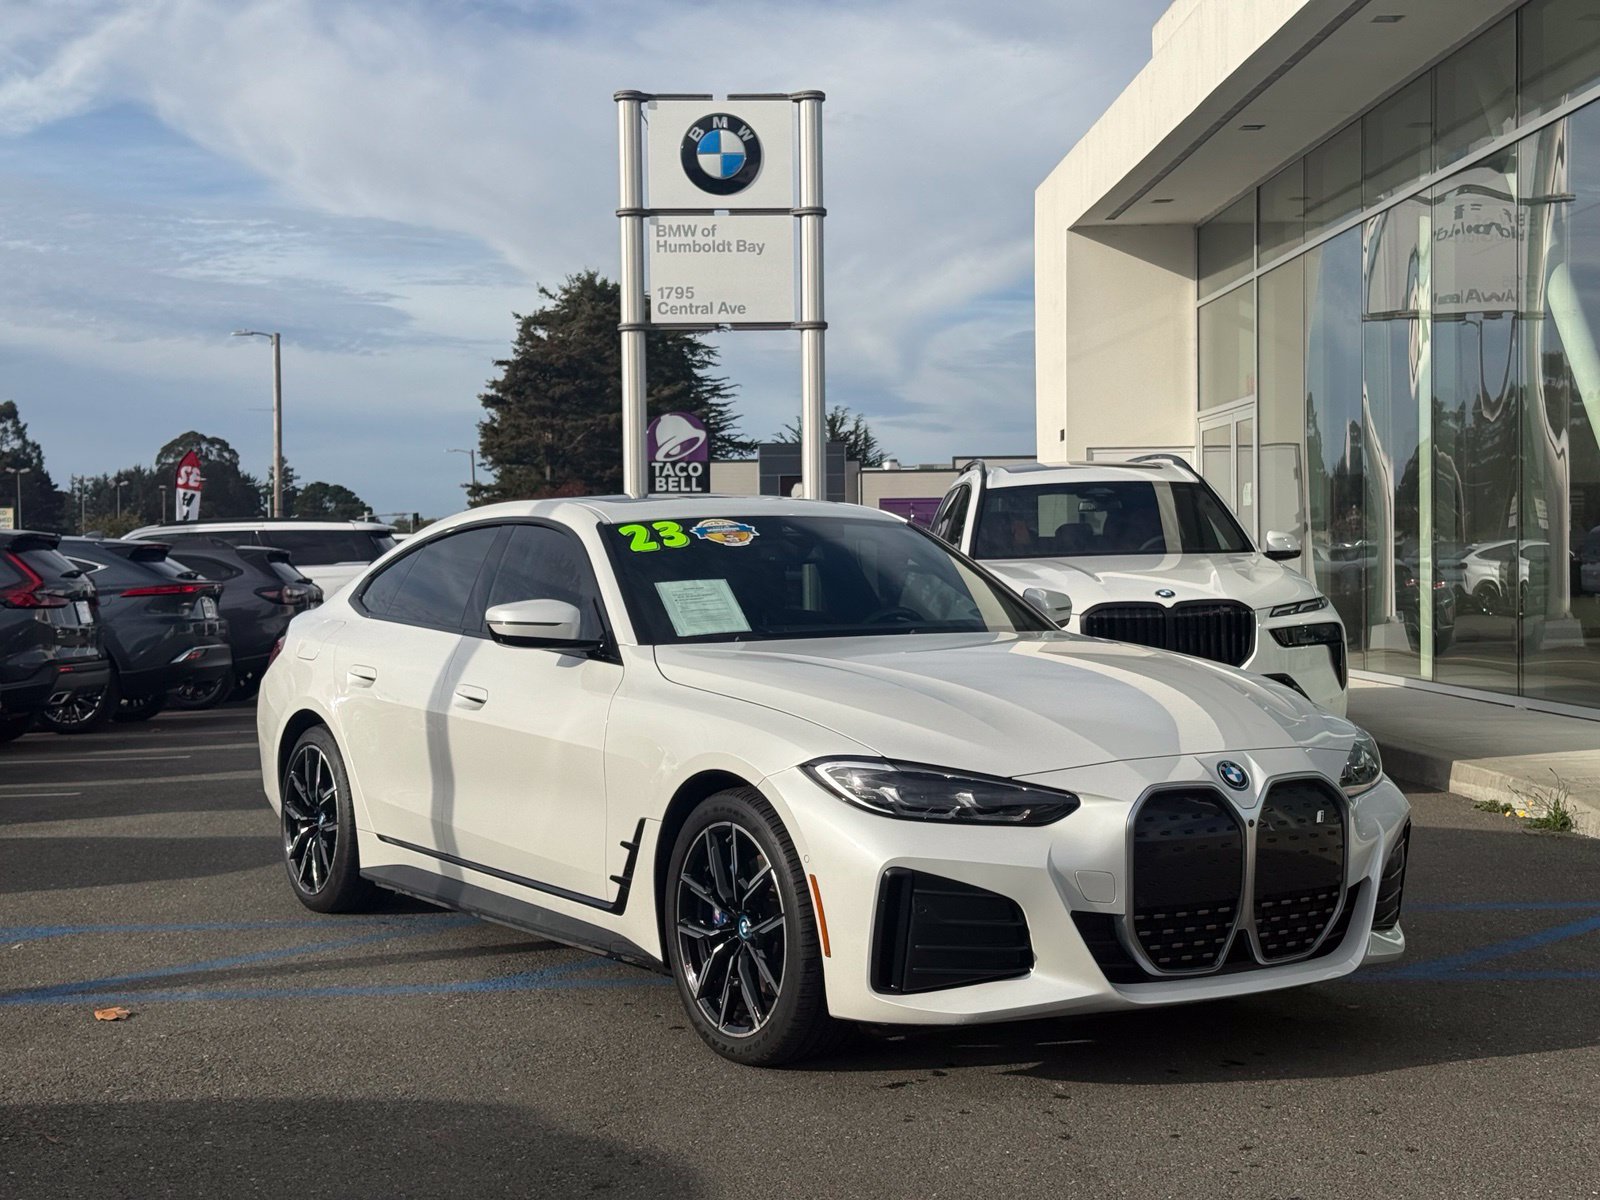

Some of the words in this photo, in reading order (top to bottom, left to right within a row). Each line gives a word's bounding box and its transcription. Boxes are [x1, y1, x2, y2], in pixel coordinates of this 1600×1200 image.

[686, 116, 755, 143] BMW
[656, 224, 698, 237] BMW
[701, 224, 717, 237] of
[656, 240, 733, 253] Humboldt
[736, 240, 765, 255] Bay
[657, 286, 695, 300] 1795
[657, 302, 713, 315] Central
[718, 301, 747, 315] Ave
[651, 462, 703, 477] TACO
[655, 477, 702, 492] BELL
[618, 520, 690, 552] 23
